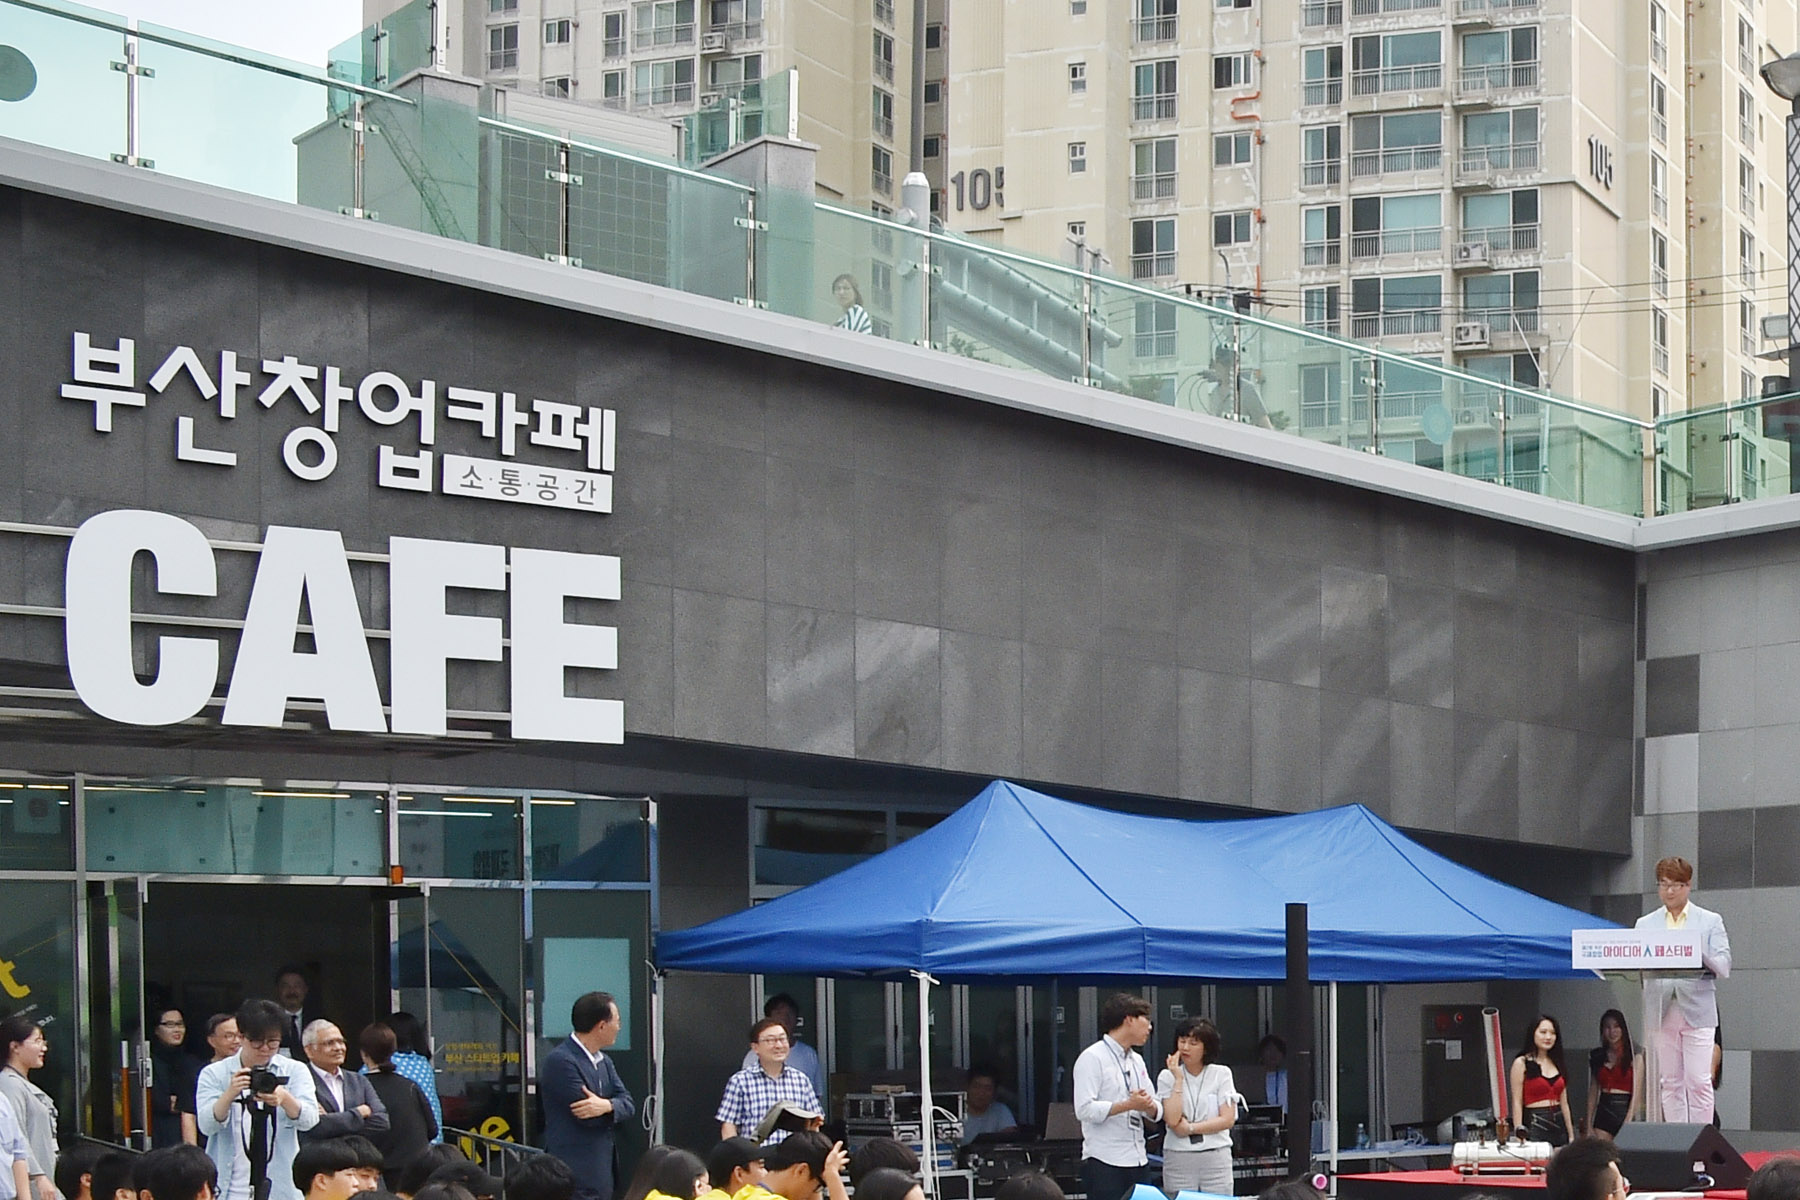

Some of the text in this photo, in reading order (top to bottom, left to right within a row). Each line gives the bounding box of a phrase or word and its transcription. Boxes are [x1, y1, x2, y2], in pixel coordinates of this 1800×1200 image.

[60, 331, 617, 492] 부산창업카페
[64, 508, 625, 745] CAFE
[1603, 945, 1642, 958] 아이디어
[1654, 944, 1693, 958] 페스티벌
